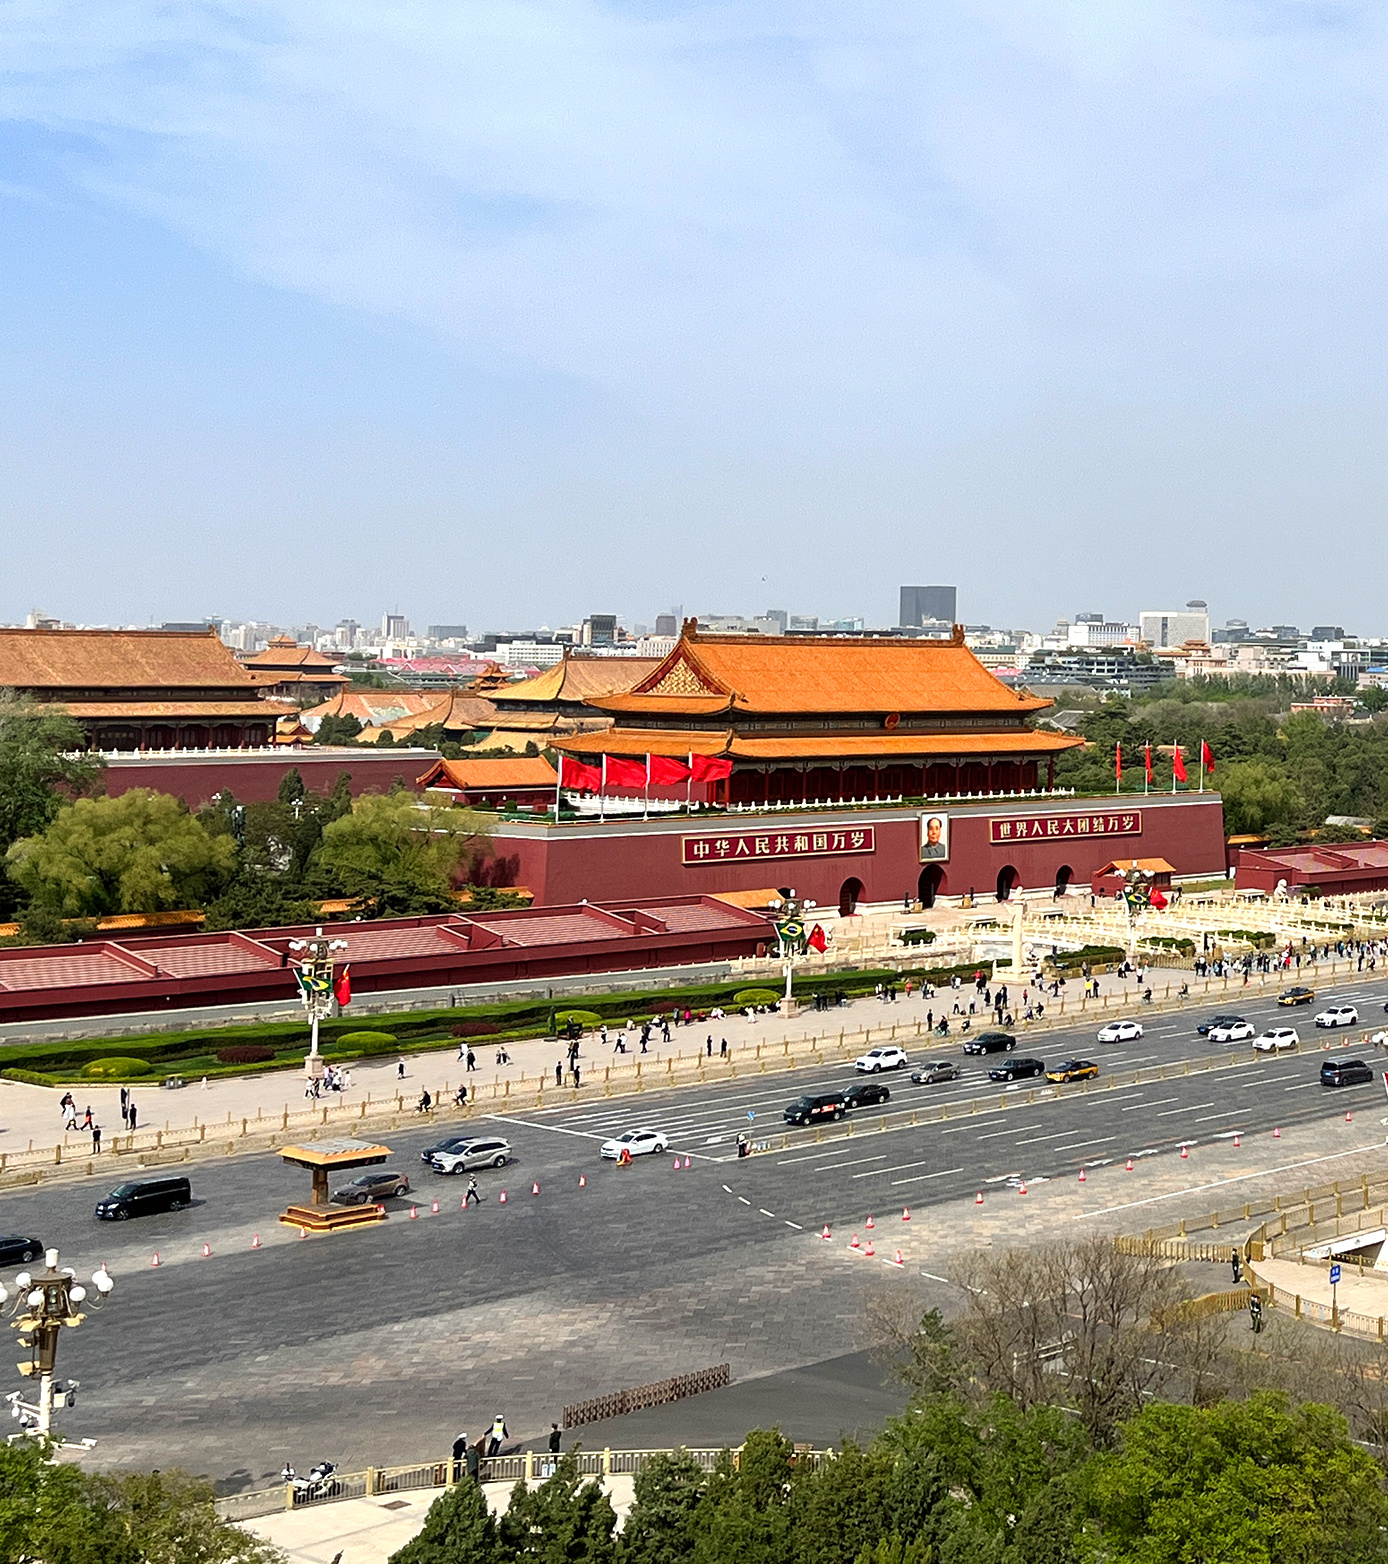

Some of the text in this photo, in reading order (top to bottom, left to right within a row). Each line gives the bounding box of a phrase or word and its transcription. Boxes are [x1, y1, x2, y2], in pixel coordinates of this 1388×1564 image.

[1000, 816, 1134, 838] 世界人民大团结万岁
[694, 831, 865, 859] 中华人民共和国万岁
